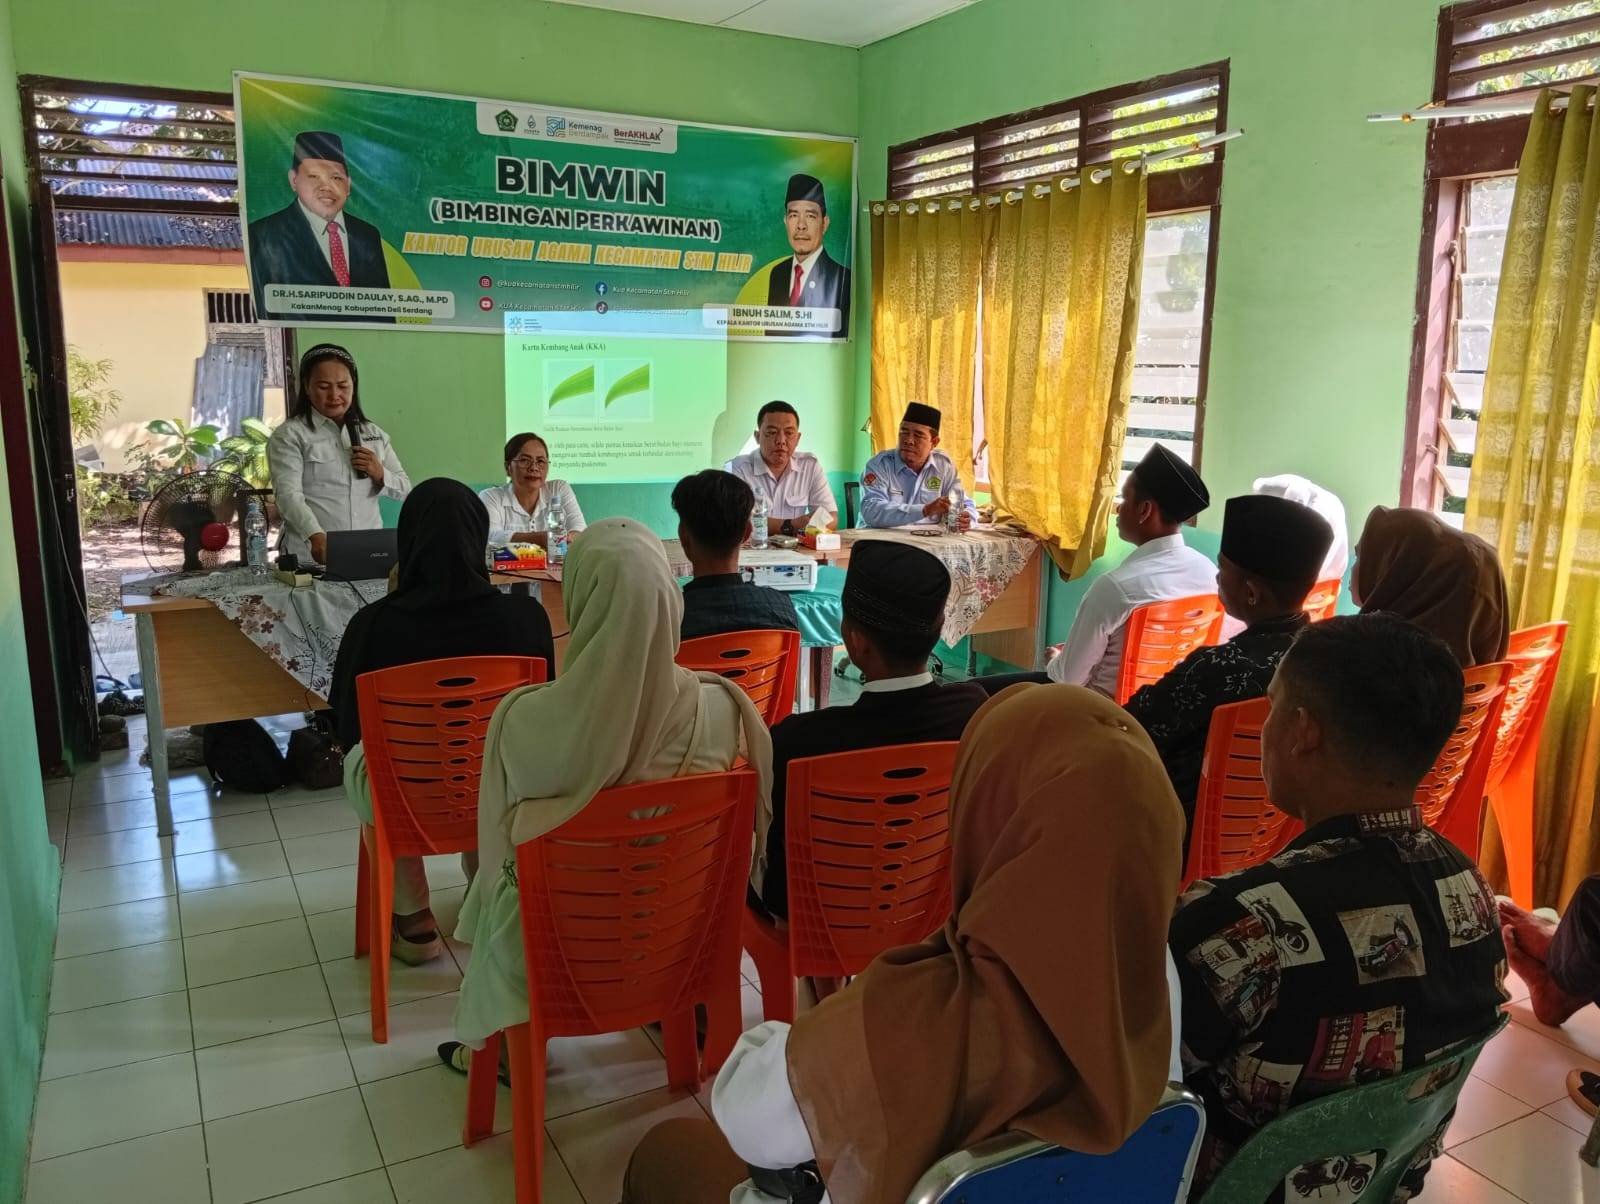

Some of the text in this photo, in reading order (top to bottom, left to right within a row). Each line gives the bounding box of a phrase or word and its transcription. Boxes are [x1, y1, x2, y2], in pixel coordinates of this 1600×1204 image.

[569, 121, 603, 133] Kemenag
[614, 127, 661, 141] BerAKHLAK
[496, 156, 667, 206] BIMWIN
[429, 197, 722, 243] (BIMBINGAN PERKAWINAN)
[403, 232, 753, 273] KANTOR URUSAN AGAMA KECAMATAN STM HILIR
[272, 289, 449, 304] DR.H.SARIPUDDIN DAULAY, S.AG., M.PD
[344, 304, 386, 314] Kabupaten
[387, 306, 402, 314] Deli
[403, 306, 433, 316] Serdang
[733, 308, 812, 320] IBNUH SALIM, S.HI
[585, 342, 607, 352] (KKA)
